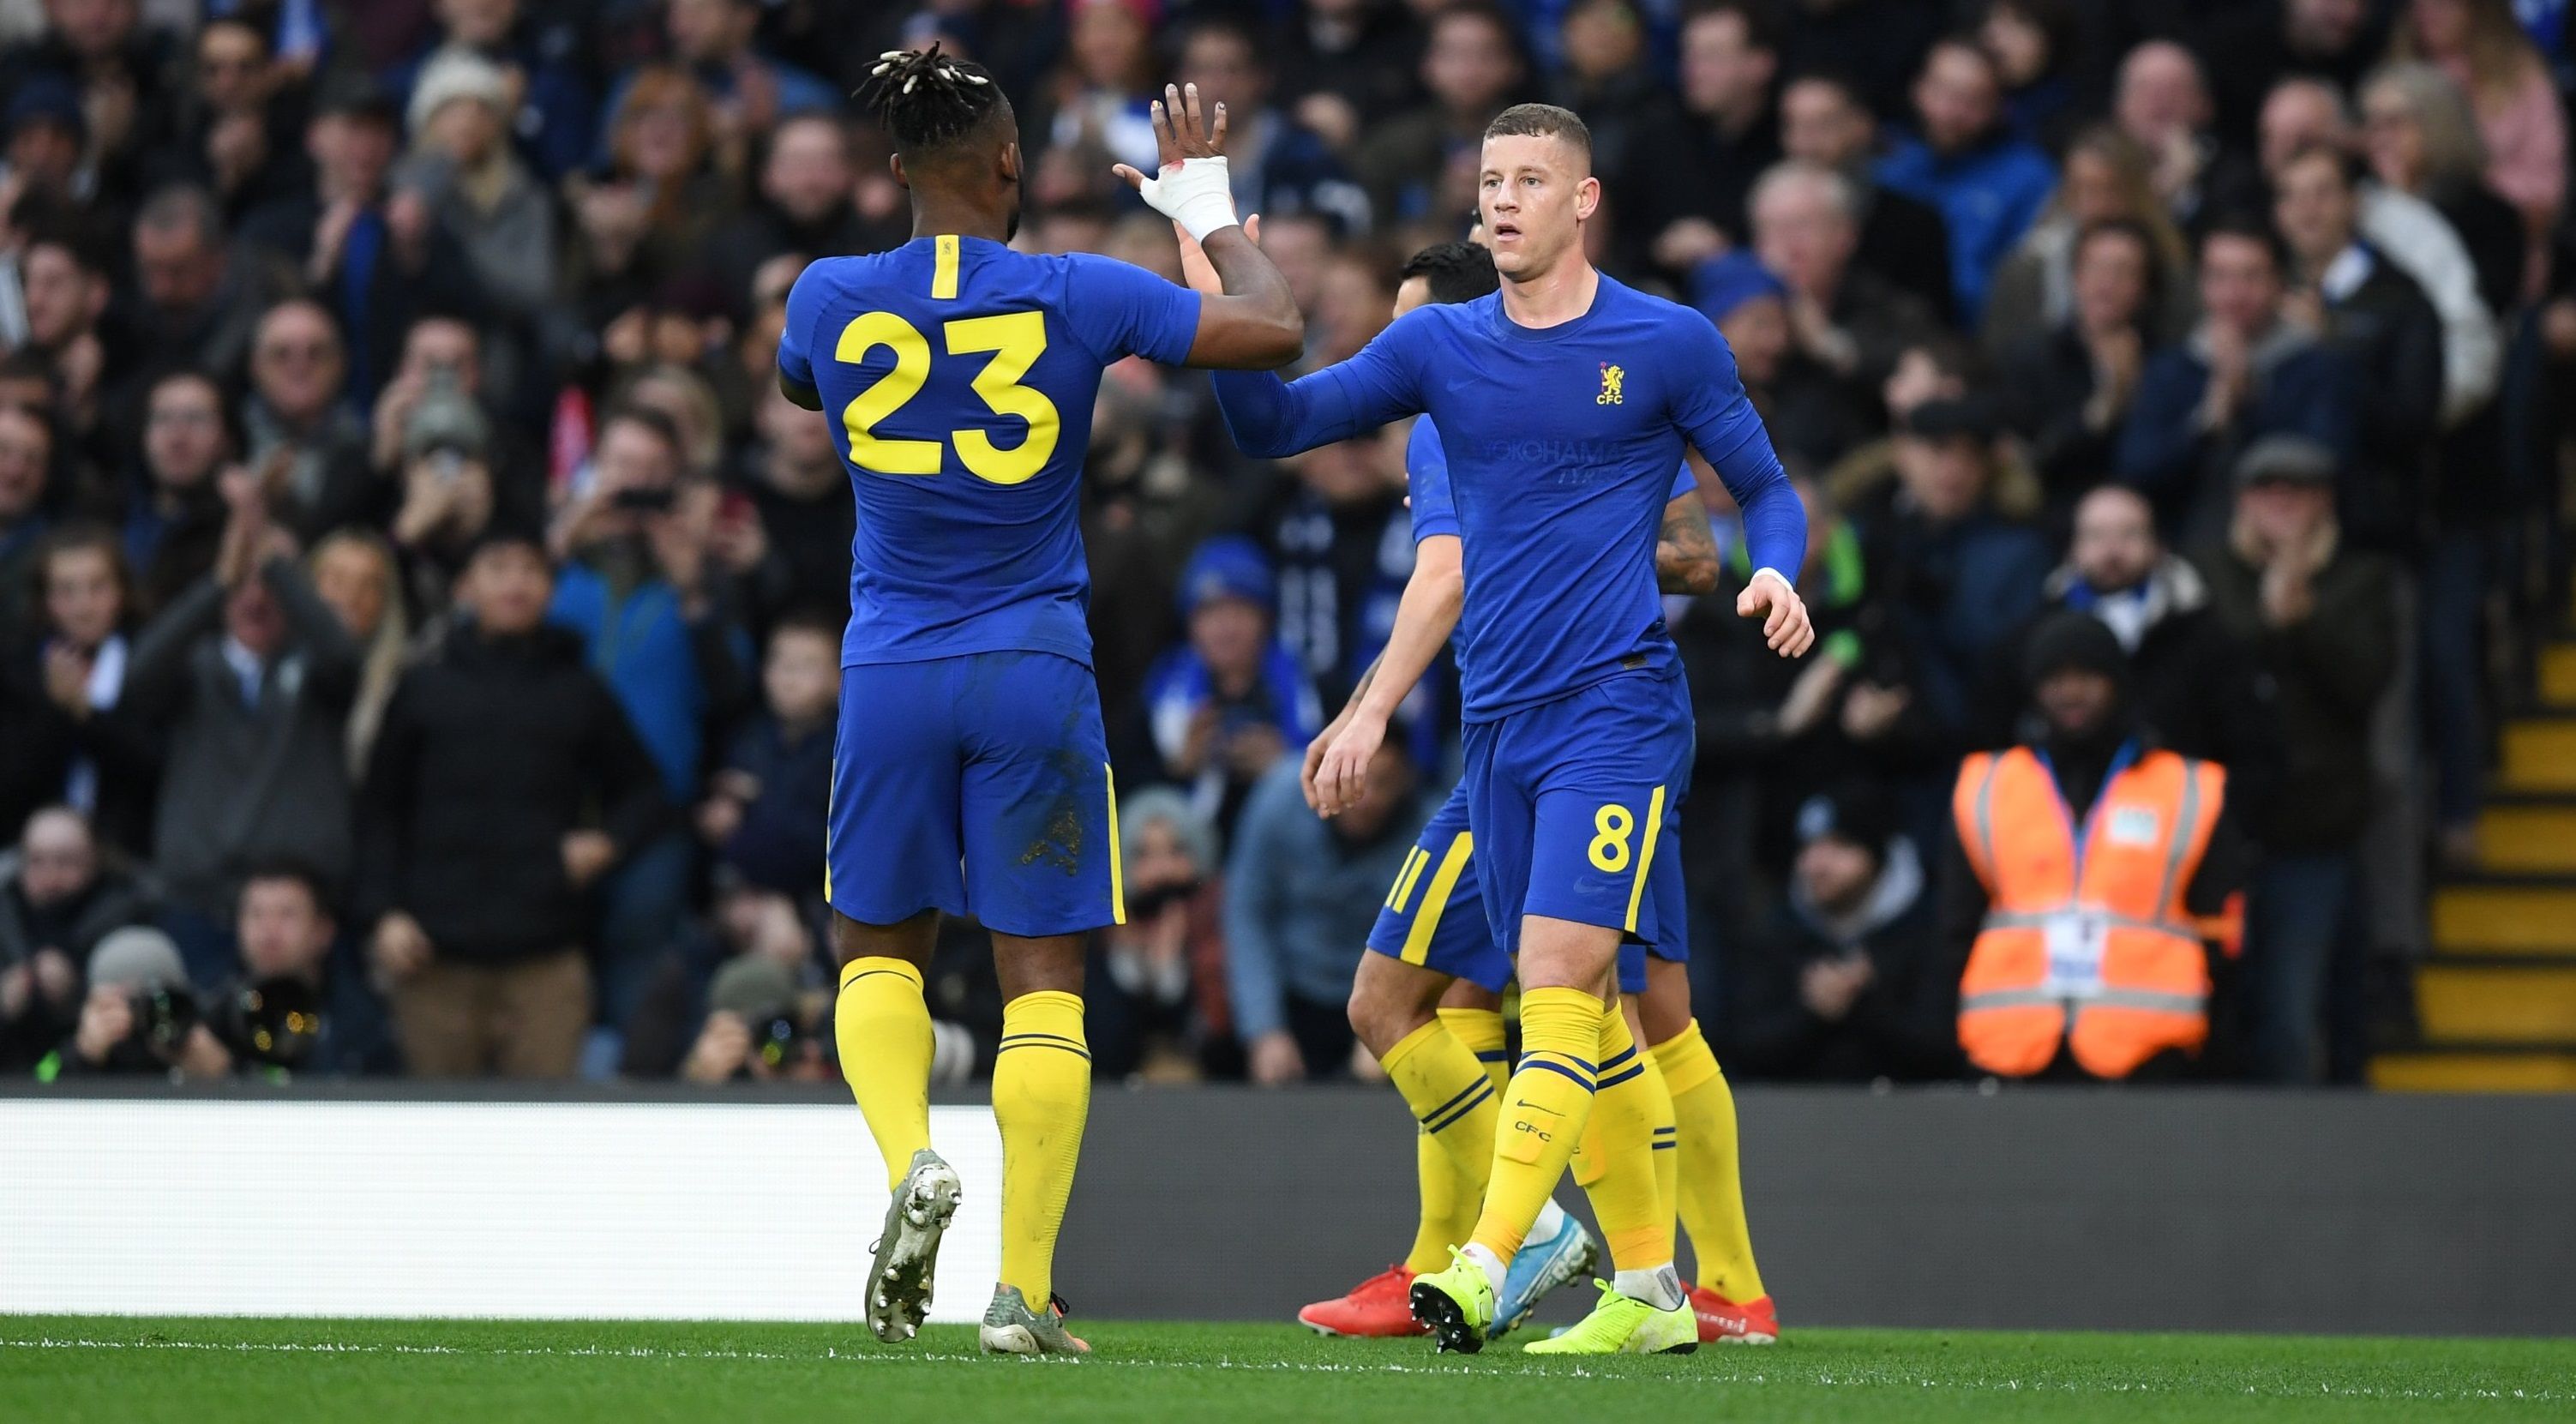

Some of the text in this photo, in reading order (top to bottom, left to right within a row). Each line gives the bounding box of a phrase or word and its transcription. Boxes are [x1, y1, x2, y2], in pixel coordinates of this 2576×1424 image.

[835, 310, 1060, 484] 23
[1596, 394, 1623, 405] CFC
[1558, 467, 1618, 484] TYR
[1588, 804, 1634, 873] 8
[1385, 845, 1430, 913] 11
[1515, 1121, 1552, 1143] CFC
